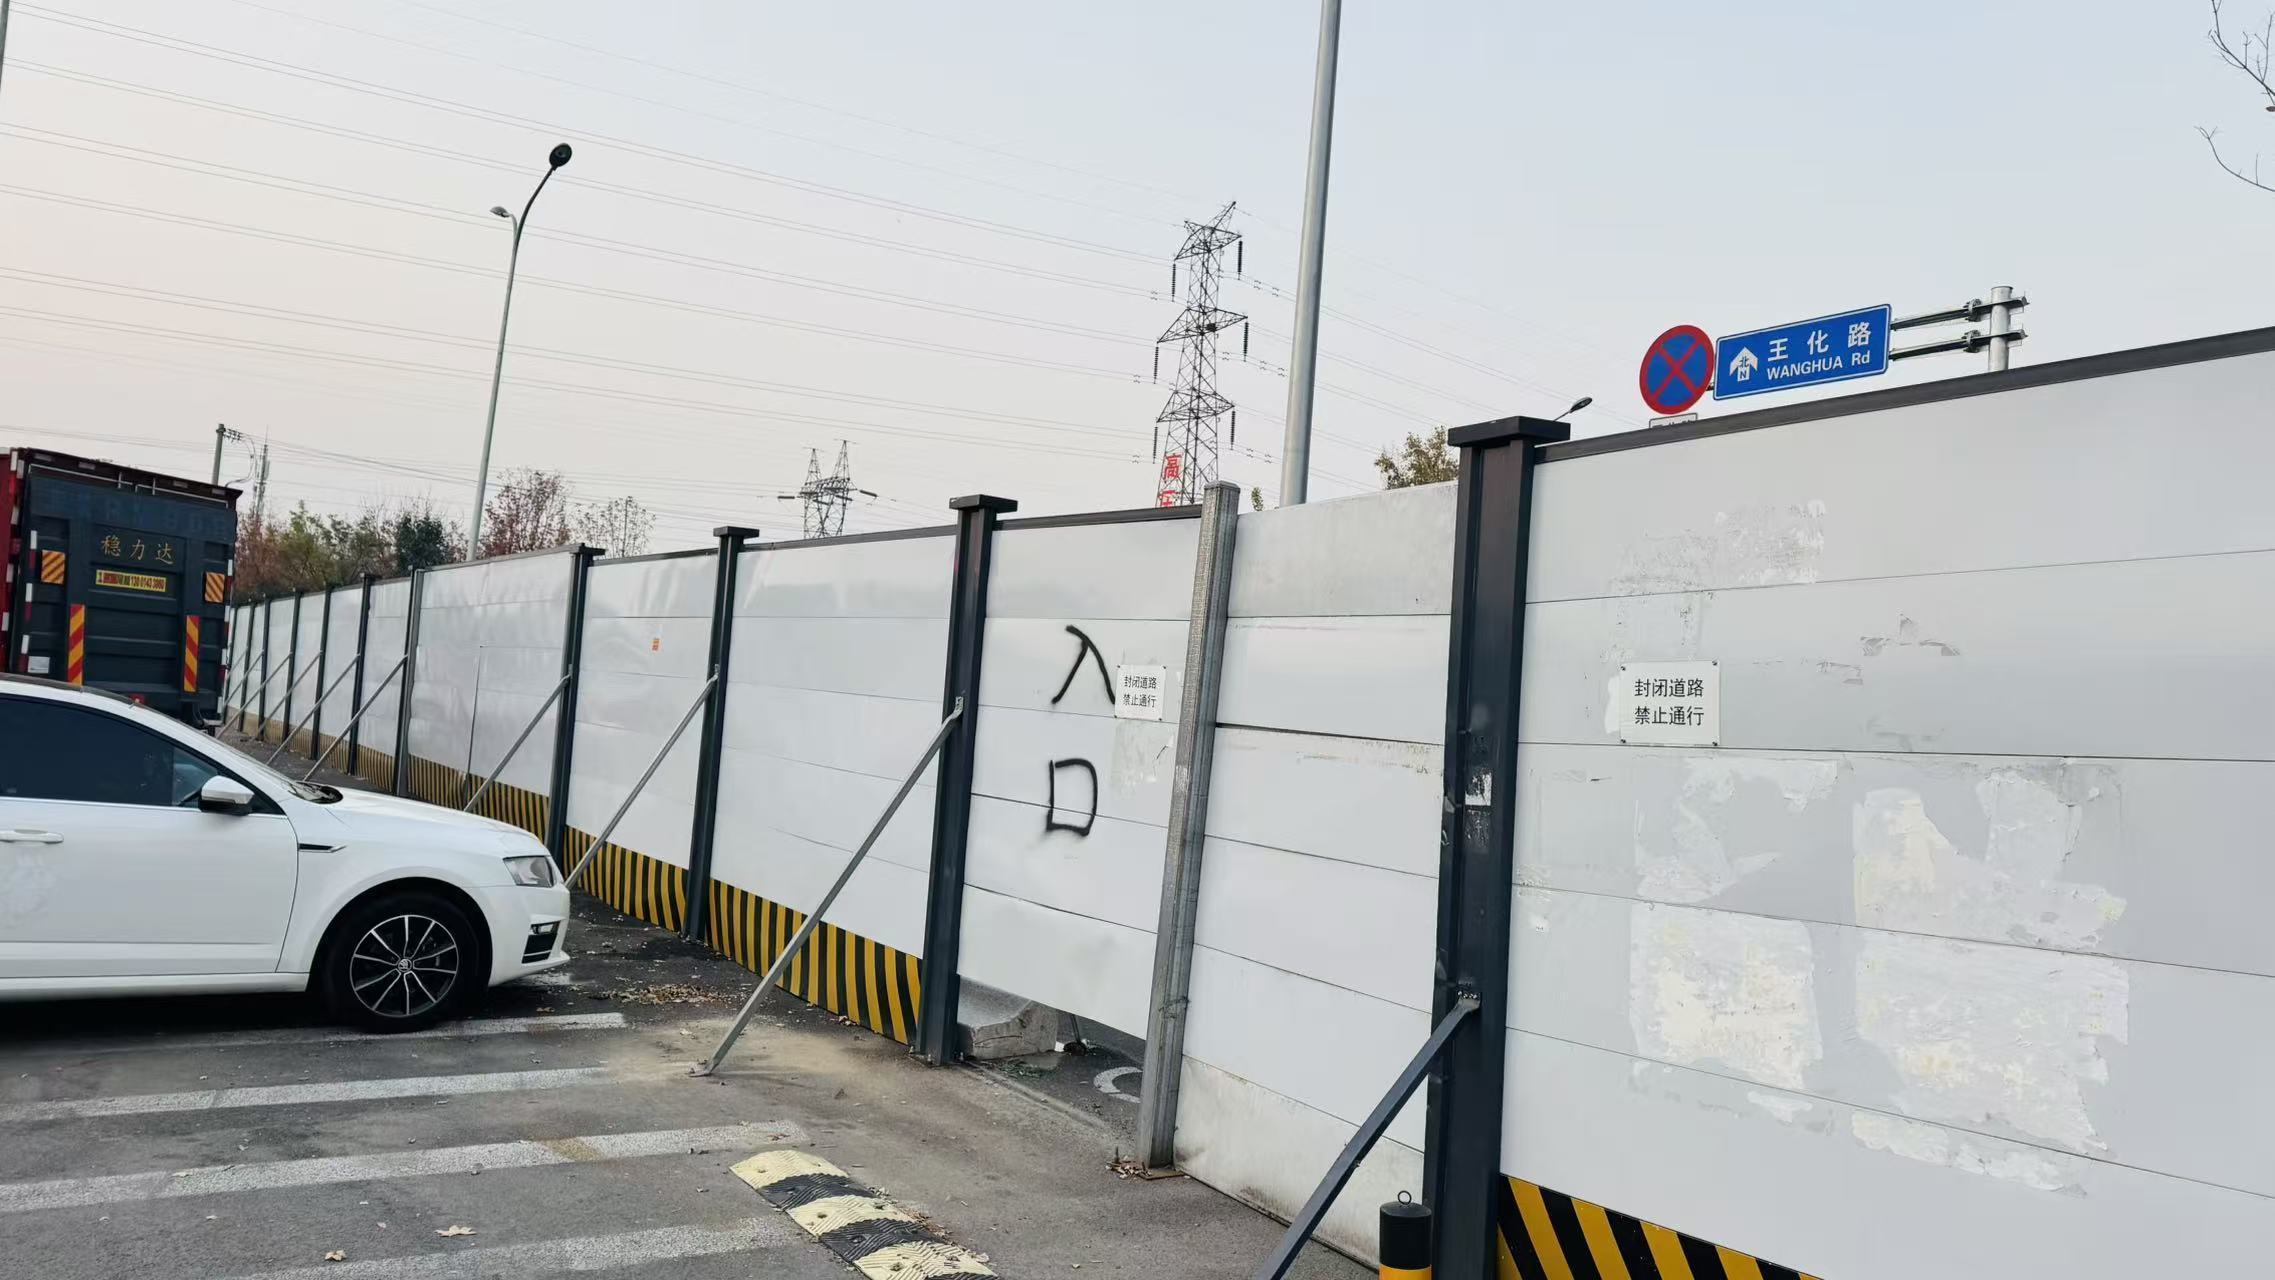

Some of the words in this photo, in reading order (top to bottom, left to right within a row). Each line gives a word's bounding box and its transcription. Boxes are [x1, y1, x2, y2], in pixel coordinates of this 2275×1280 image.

[1767, 321, 1871, 362] 王化路
[1739, 355, 1750, 369] 北
[1767, 357, 1844, 381] WANGHUA
[1851, 349, 1870, 366] Rd
[1739, 370, 1747, 379] N
[101, 534, 174, 564] 稳力达
[1123, 675, 1158, 690] 封闭道路
[1633, 677, 1705, 698] 封闭道路
[1122, 693, 1157, 708] 禁止通行
[1633, 705, 1705, 726] 禁止通行
[1046, 624, 1116, 837] 入口
